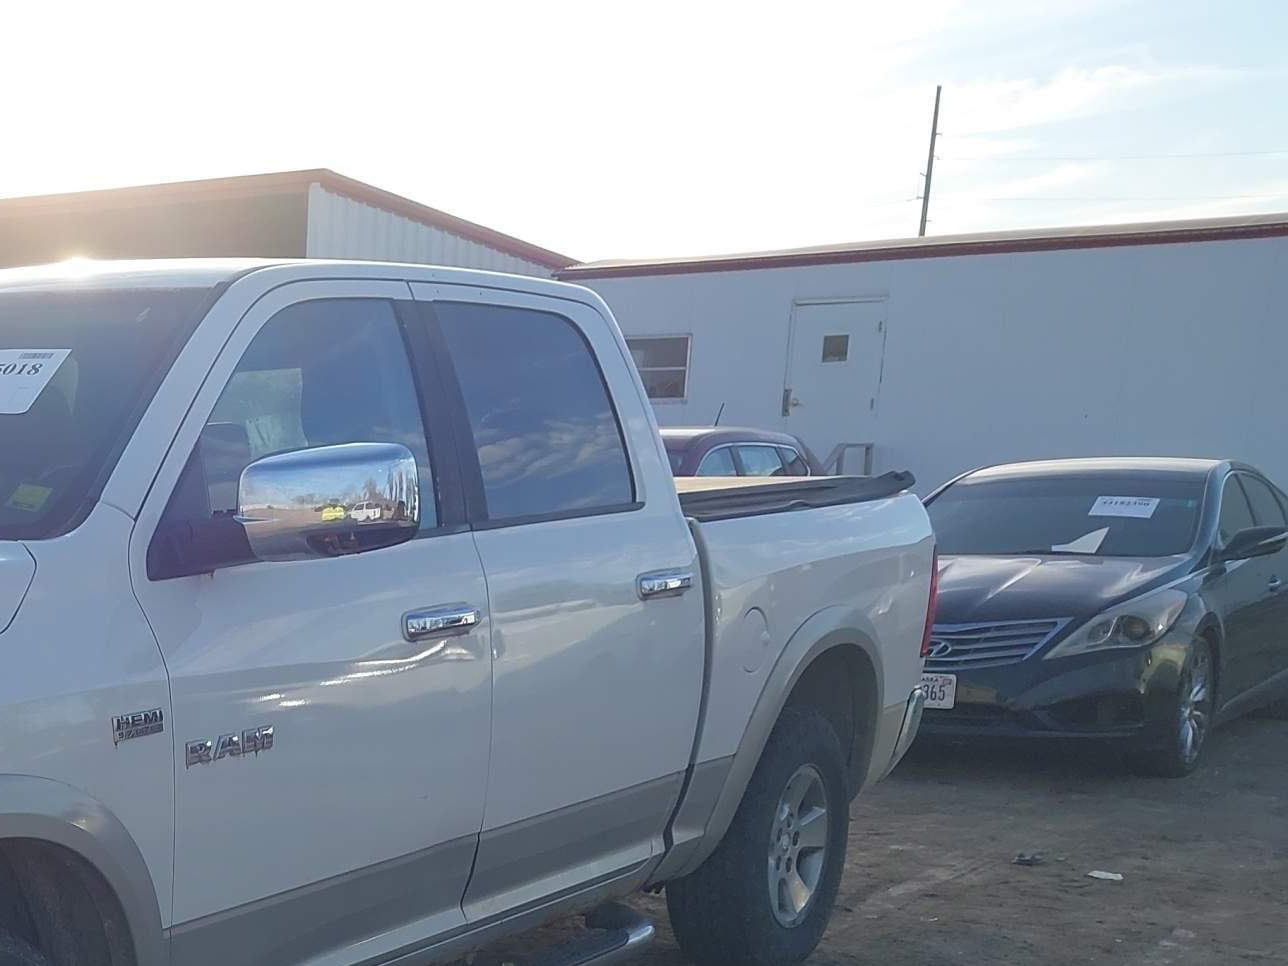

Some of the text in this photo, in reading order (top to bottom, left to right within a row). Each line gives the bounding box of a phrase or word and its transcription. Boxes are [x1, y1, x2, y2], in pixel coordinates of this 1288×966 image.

[923, 683, 945, 701] 365
[115, 709, 164, 731] HEMI
[185, 726, 274, 769] RAM
